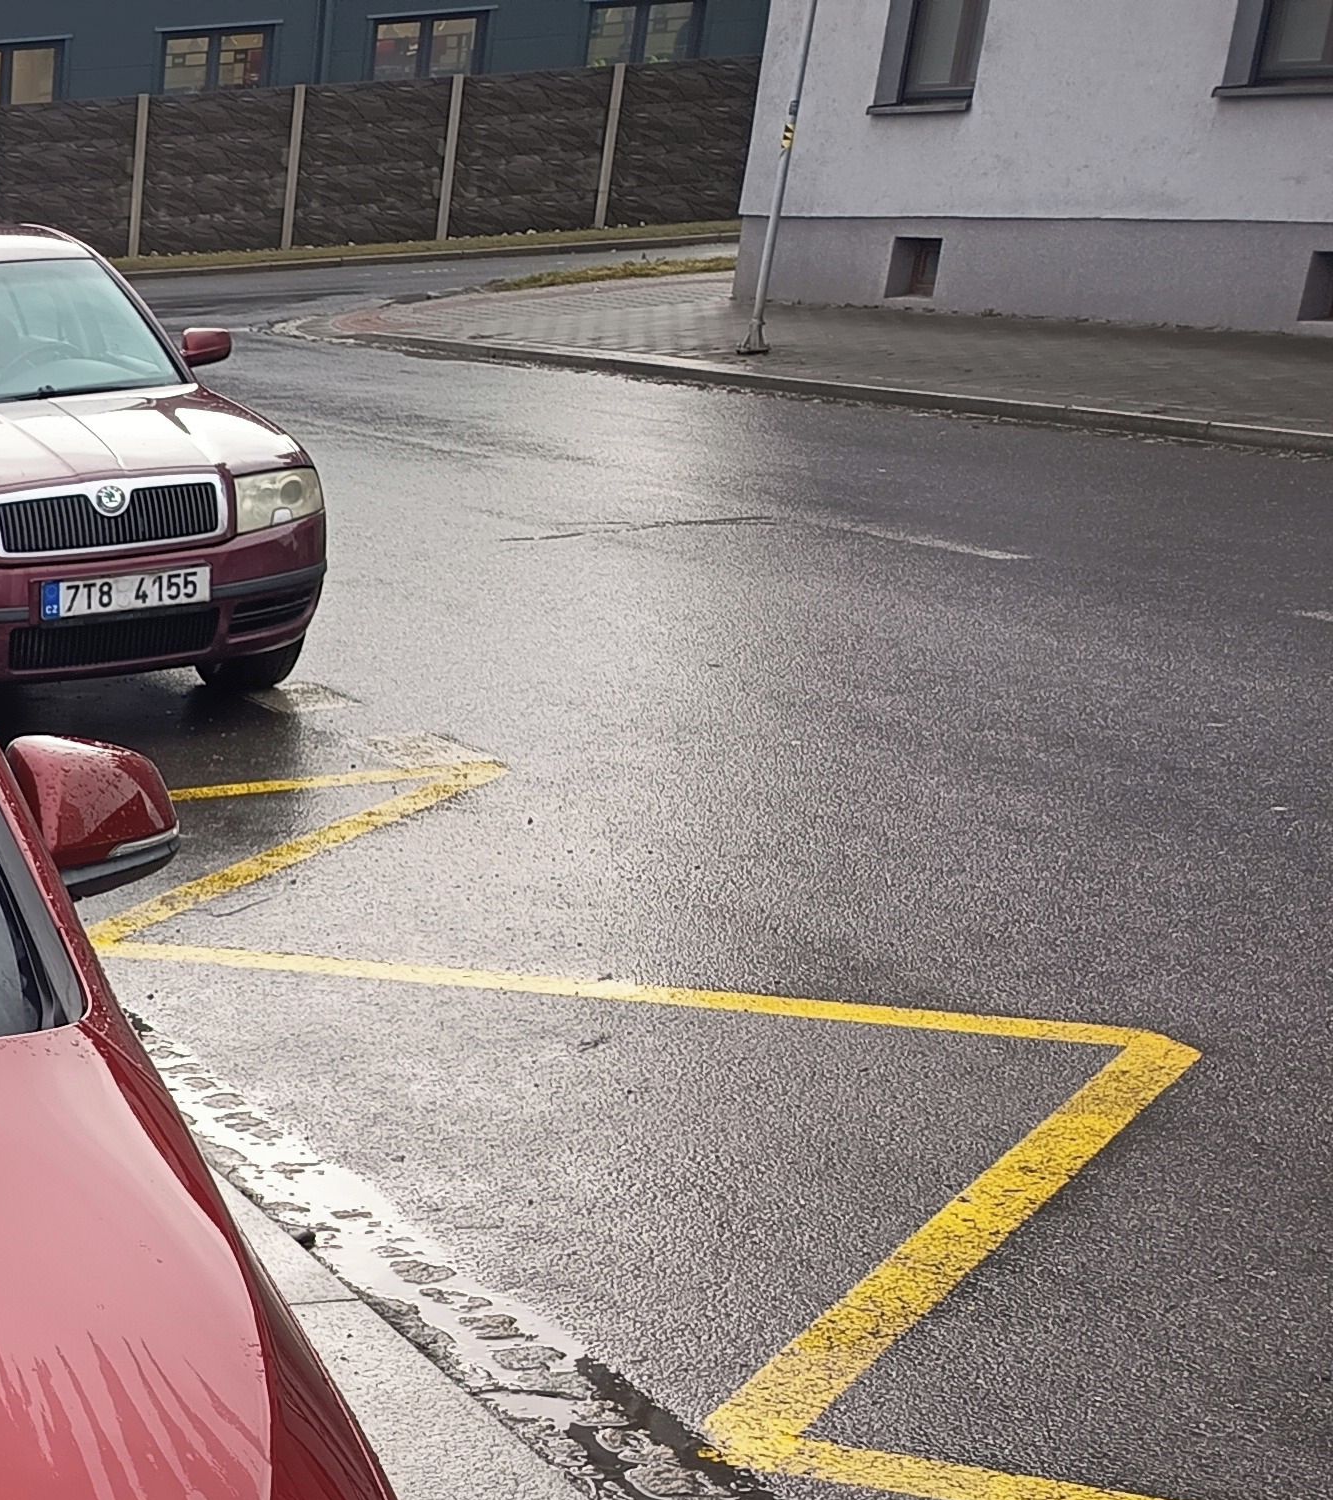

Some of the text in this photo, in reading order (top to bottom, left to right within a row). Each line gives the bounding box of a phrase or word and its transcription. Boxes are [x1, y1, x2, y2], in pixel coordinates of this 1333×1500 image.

[64, 571, 198, 613] 7T8 4155
[45, 605, 58, 614] CZ
